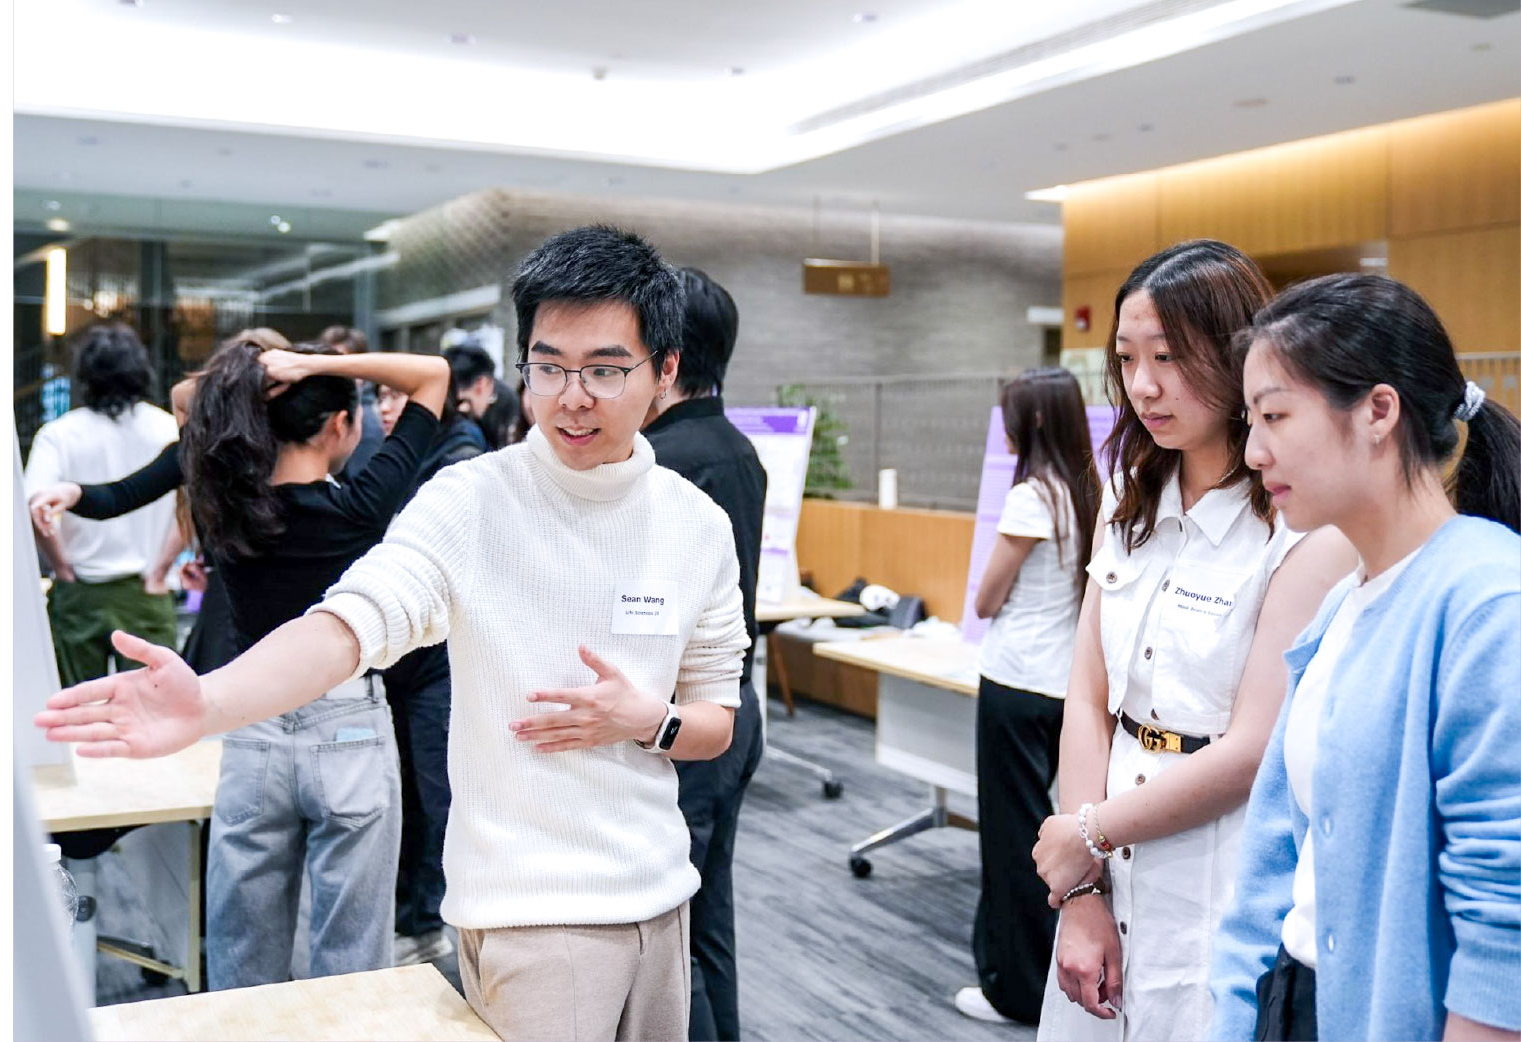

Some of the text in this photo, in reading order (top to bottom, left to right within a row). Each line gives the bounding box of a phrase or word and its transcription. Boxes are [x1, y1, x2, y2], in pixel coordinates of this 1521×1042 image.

[621, 594, 665, 606] Sean Wang
[1174, 586, 1212, 602] Zhuoyue
